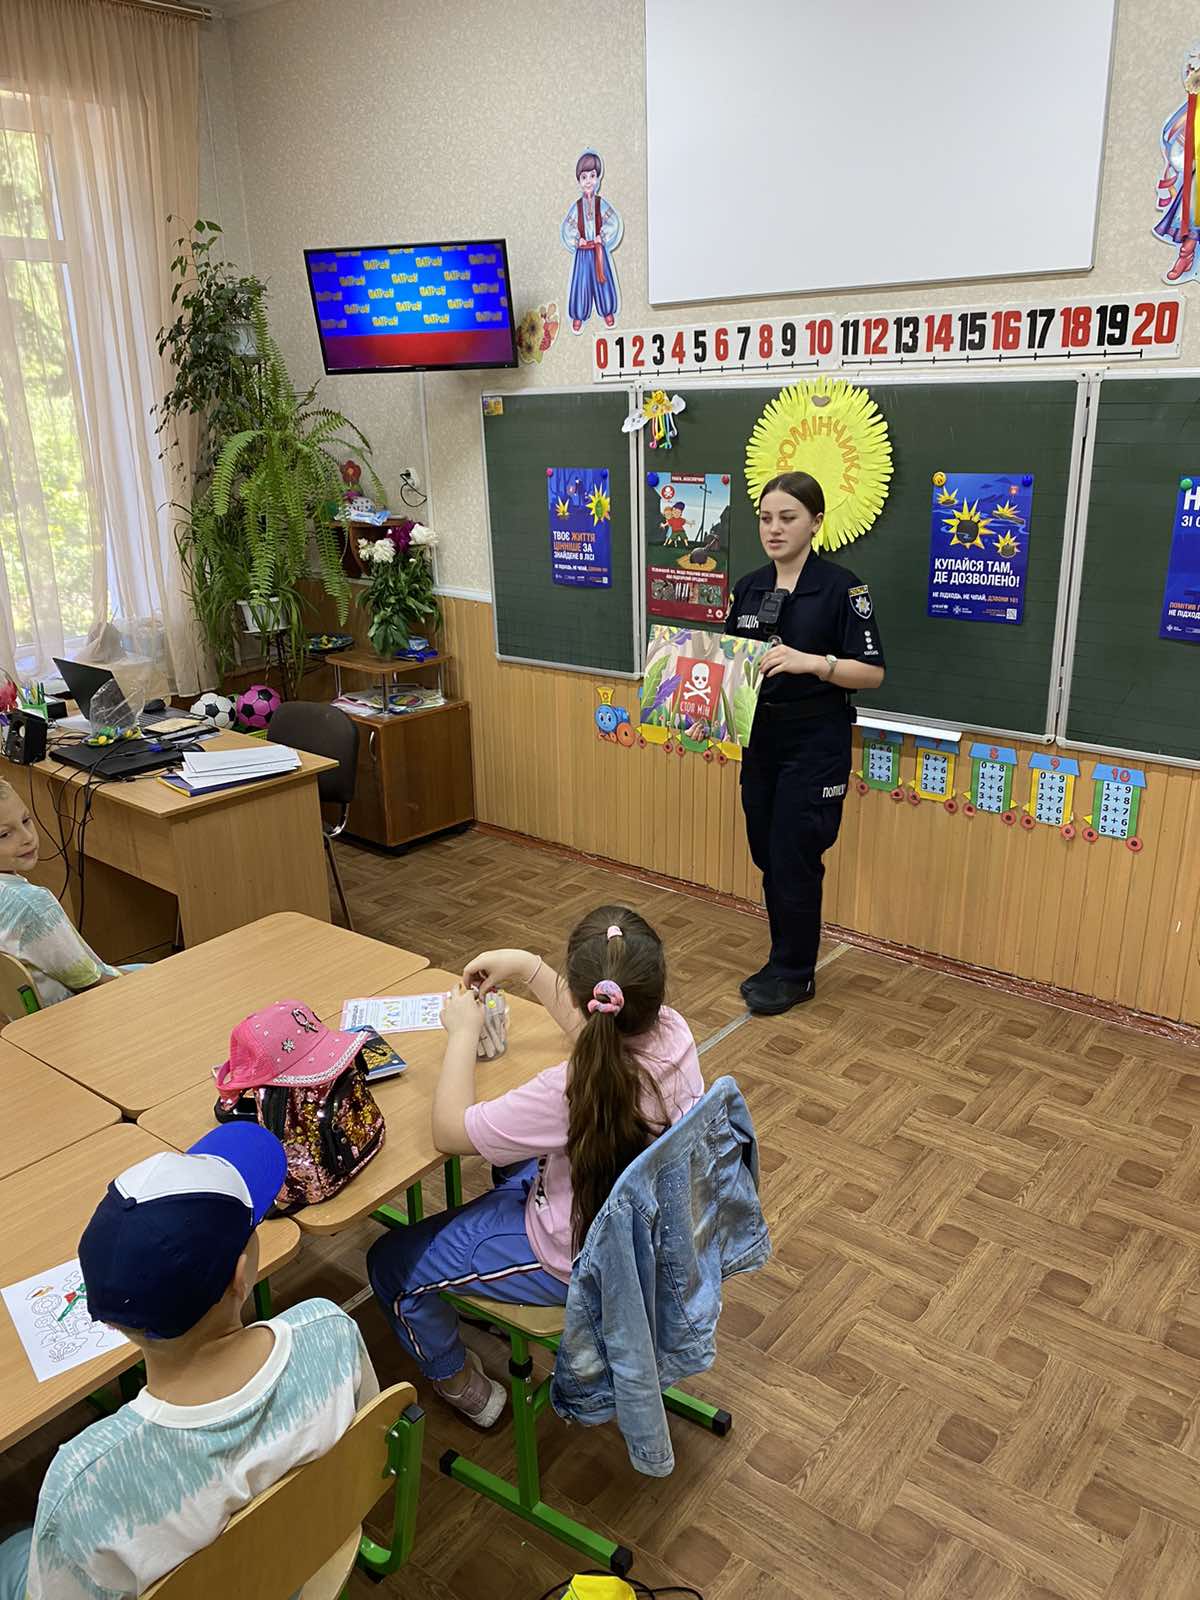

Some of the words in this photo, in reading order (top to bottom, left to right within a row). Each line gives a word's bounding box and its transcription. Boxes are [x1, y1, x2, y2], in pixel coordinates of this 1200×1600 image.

[840, 319, 859, 355] 11
[863, 317, 889, 355] 12
[893, 316, 919, 353] 13
[925, 314, 954, 352] 14
[958, 312, 987, 351] 15
[992, 310, 1022, 350] 16
[1027, 308, 1055, 349] 17
[1060, 306, 1092, 348] 18
[1096, 304, 1129, 346] 19
[1131, 301, 1179, 345] 20
[596, 338, 608, 369] 0
[615, 337, 624, 368] 1
[632, 335, 645, 367] 2
[652, 334, 664, 365] 3
[671, 331, 686, 364] 4
[694, 329, 707, 362] 5
[715, 327, 728, 361] 6
[737, 326, 751, 360] 7
[759, 324, 773, 359] 8
[782, 322, 796, 357] 9
[805, 319, 833, 355] 10
[776, 416, 861, 494] РОМІНЧИКИ
[1181, 515, 1193, 527] ЗІ
[553, 531, 570, 540] ТВОЄ
[583, 543, 592, 552] ЗА
[935, 557, 984, 572] КУПАЙСЯ
[987, 560, 1013, 575] ТАМ,
[933, 572, 948, 584] ДЕ
[950, 572, 1020, 587] ДОЗВОЛЕНО!
[990, 747, 998, 759] 8
[1051, 758, 1059, 768] 9
[1112, 768, 1130, 782] 10
